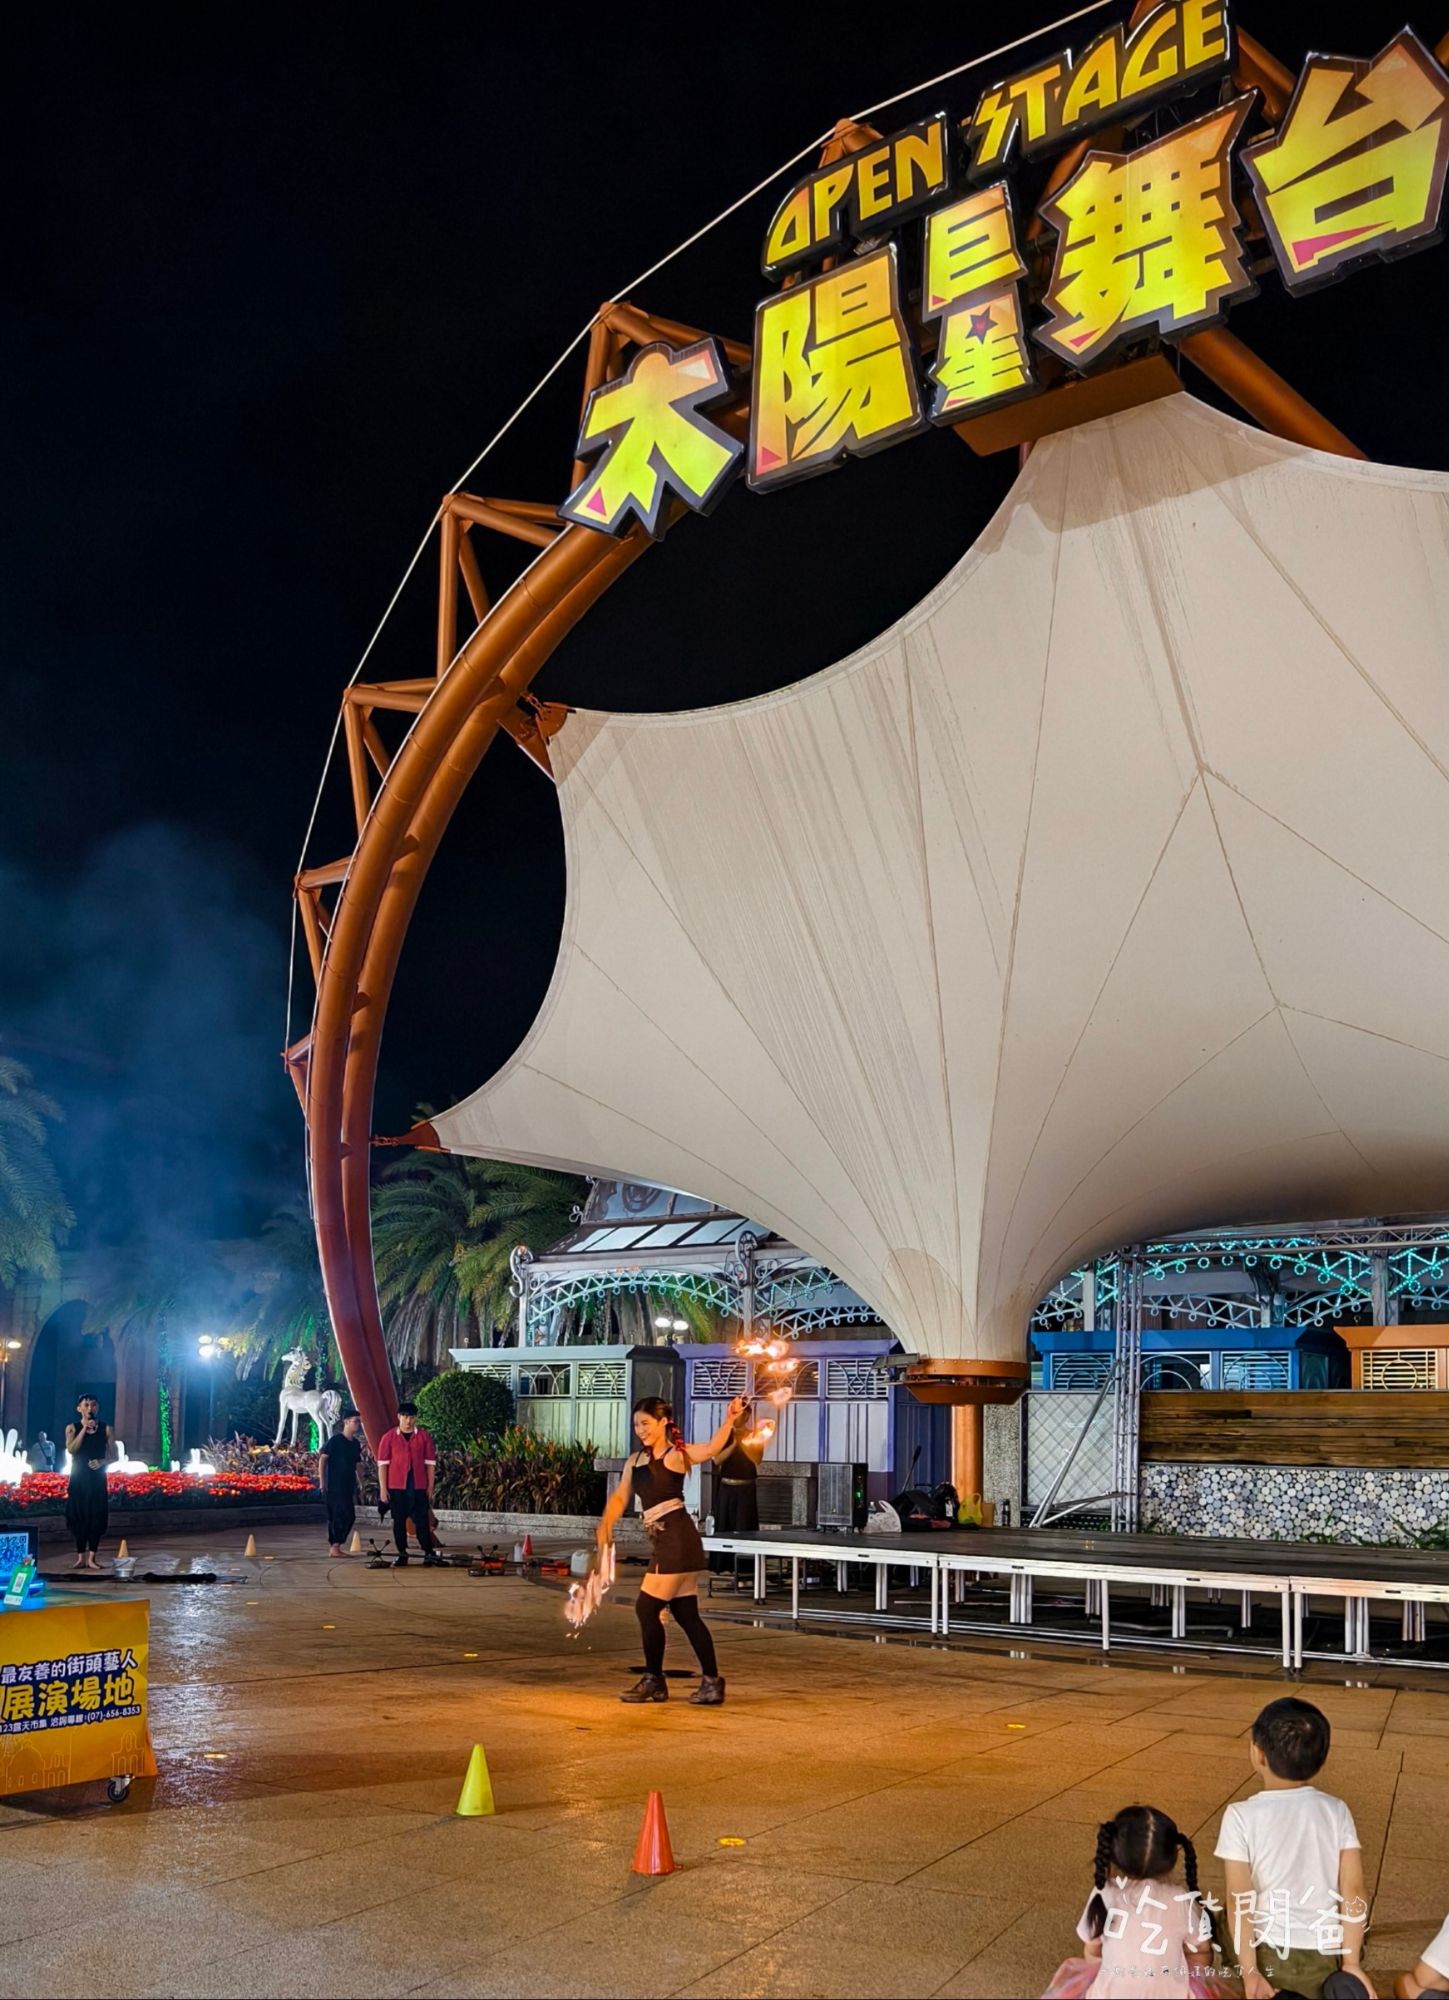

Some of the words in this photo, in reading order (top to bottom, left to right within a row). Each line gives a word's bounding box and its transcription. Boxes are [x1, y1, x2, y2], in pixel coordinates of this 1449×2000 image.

[766, 120, 945, 266] OPEN
[975, 0, 1226, 167] STAGE
[1, 1650, 138, 1684] 最友善的街頭藝人
[2, 1671, 134, 1721] 展演場地
